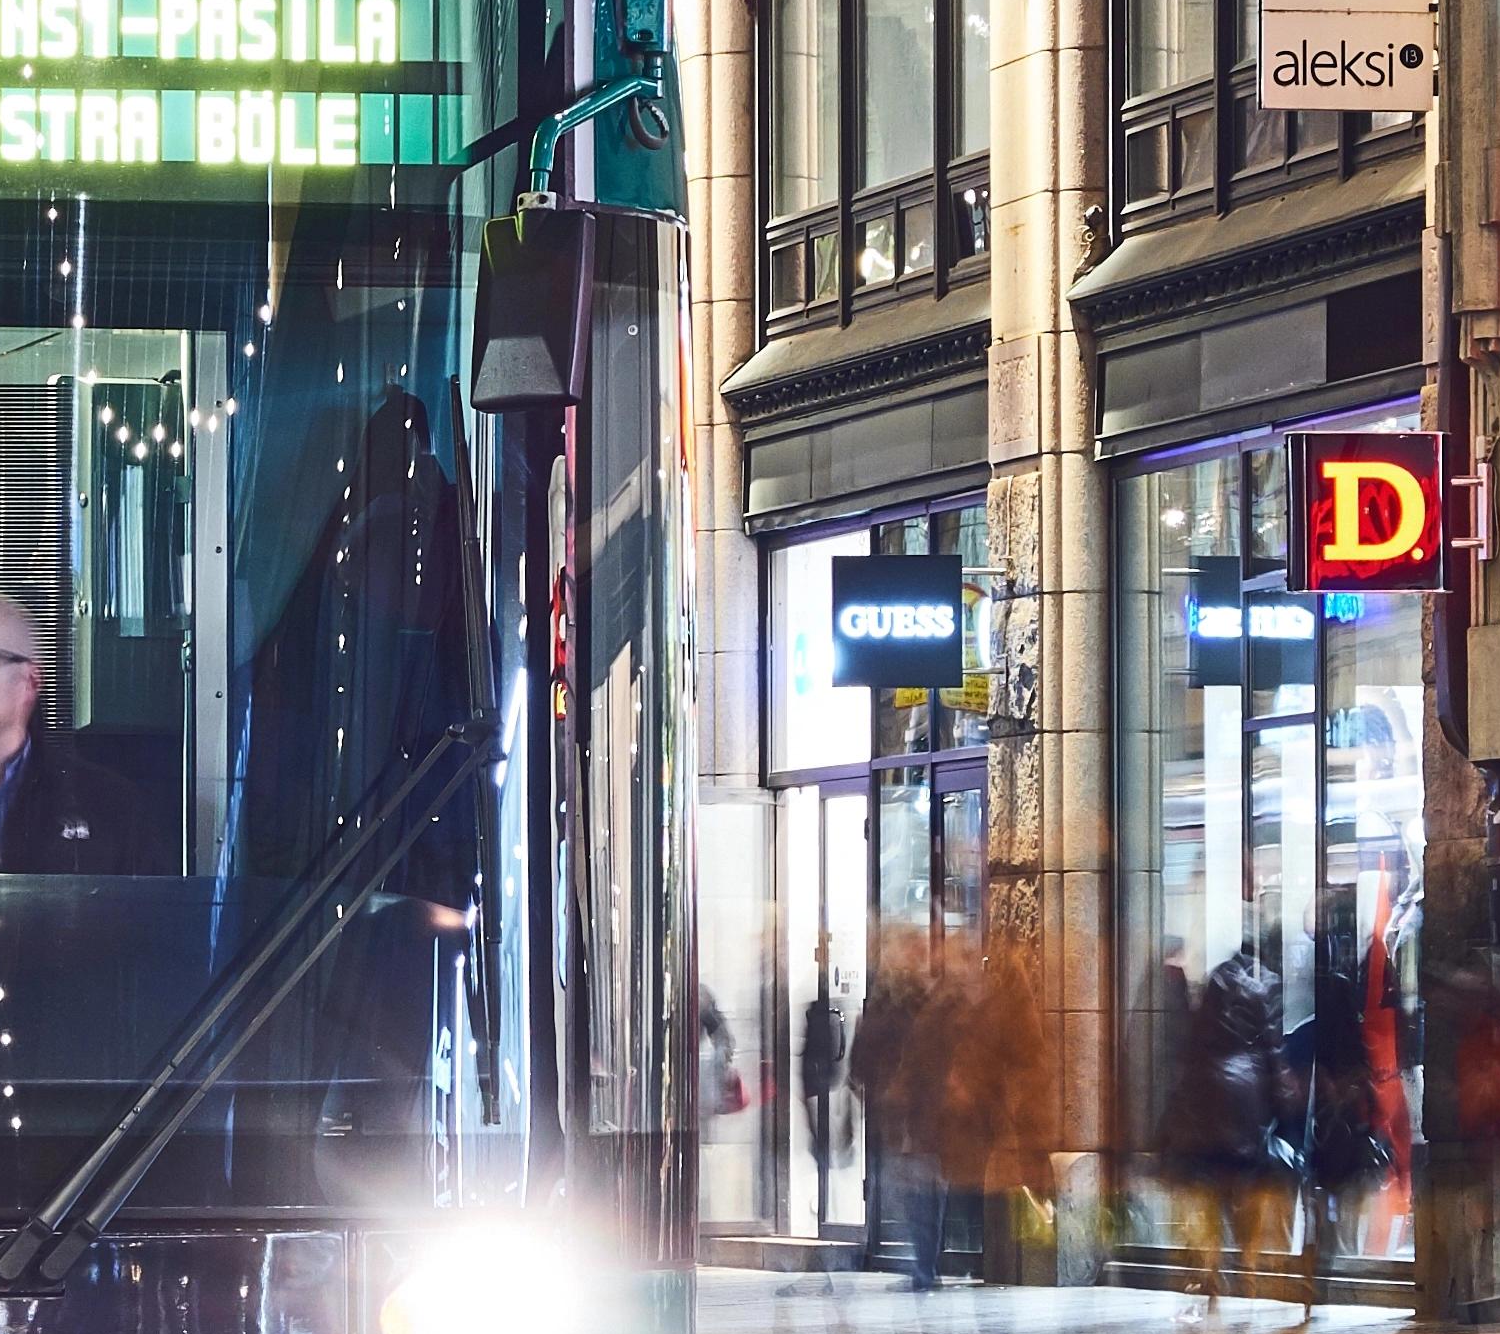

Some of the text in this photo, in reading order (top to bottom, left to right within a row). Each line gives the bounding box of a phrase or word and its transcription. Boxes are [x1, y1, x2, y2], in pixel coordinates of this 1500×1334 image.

[1273, 37, 1395, 89] aleksi
[199, 89, 360, 167] BÖLE
[839, 604, 956, 639] GUESS
